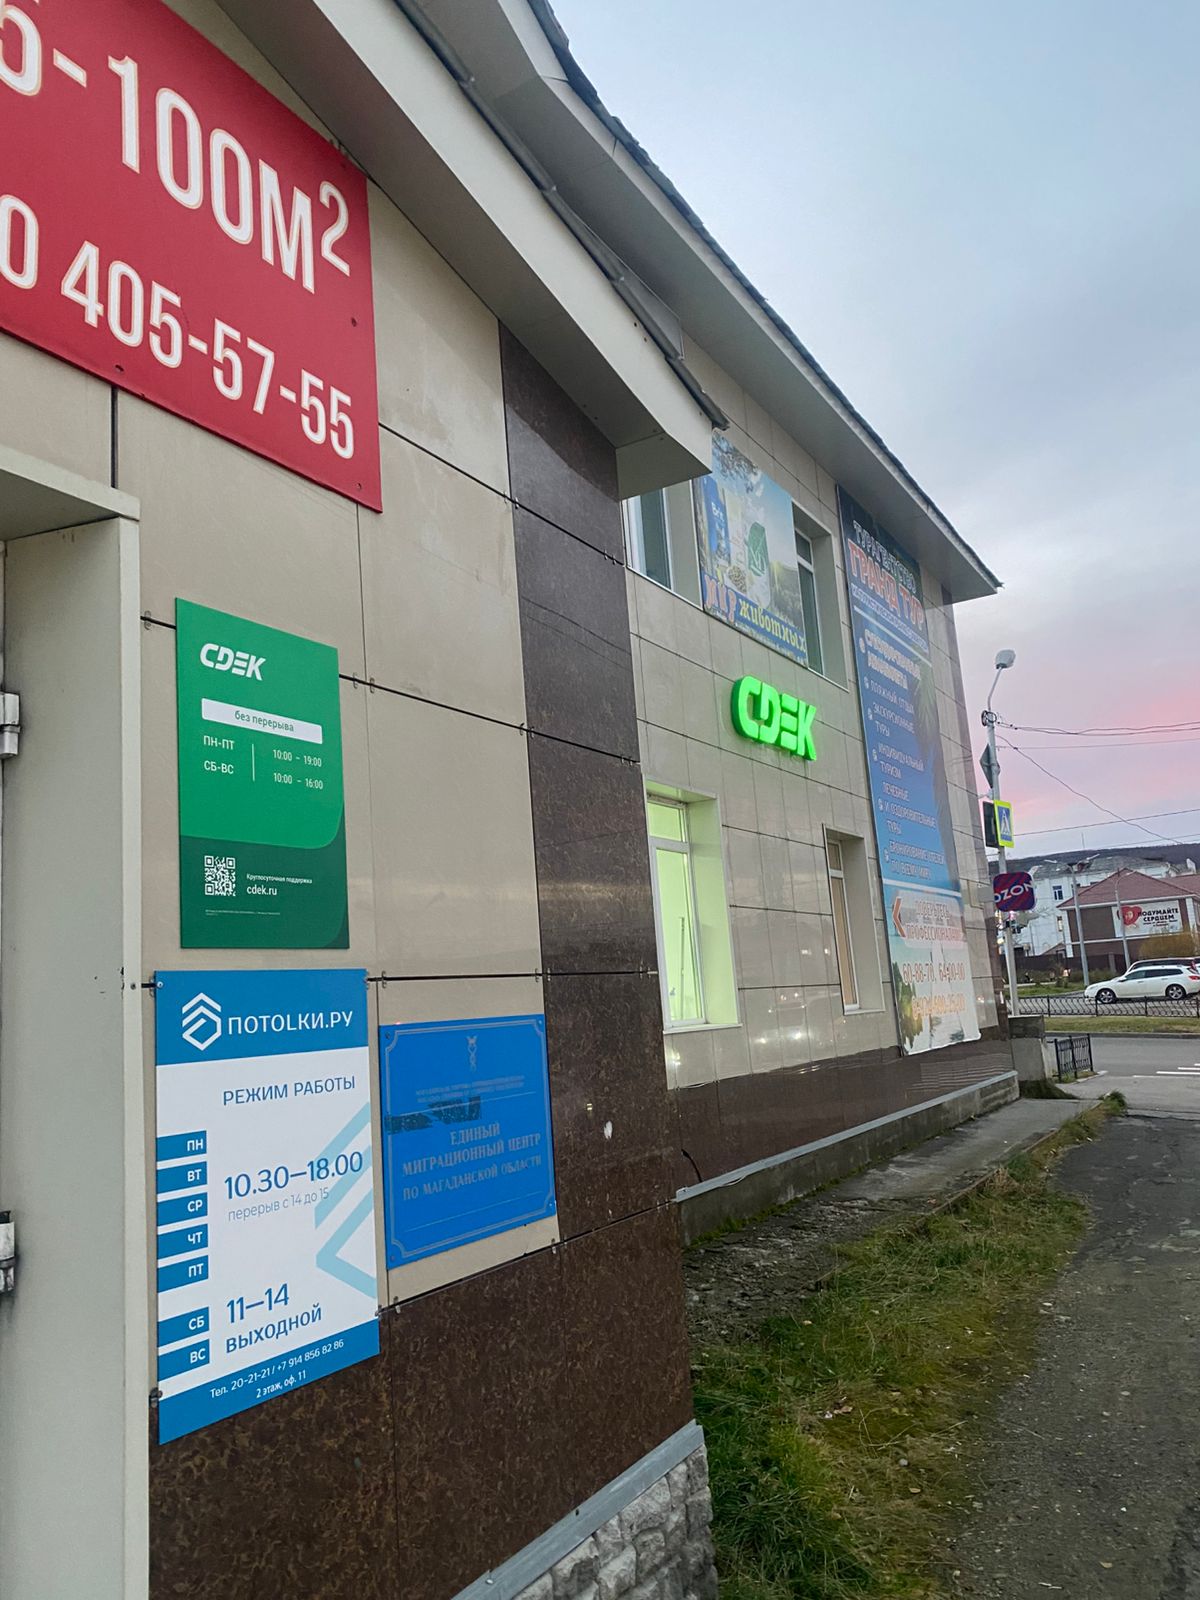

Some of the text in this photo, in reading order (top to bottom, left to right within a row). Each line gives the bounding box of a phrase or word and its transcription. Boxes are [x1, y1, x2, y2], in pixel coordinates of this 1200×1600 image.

[61, 241, 354, 459] 405-57-55
[848, 538, 901, 618] ГРАНД
[899, 583, 924, 631] ТУР
[200, 643, 266, 681] CDEK
[234, 710, 294, 732] без перерыва
[730, 674, 817, 762] CDEK
[203, 735, 235, 750] ПН-ПТ
[273, 749, 293, 761] 10:00
[303, 755, 322, 767] 19:00
[204, 760, 234, 774] СБ-ВС
[273, 773, 292, 784] 10:00
[305, 778, 323, 789] 16:00
[247, 884, 277, 895] cdek.ru
[223, 1076, 356, 1106] РЕЖИМ РАБОТЫ
[187, 1139, 204, 1151] ПН
[450, 1122, 500, 1146] ЕДИНЫЙ
[402, 1133, 541, 1177] МИГРАЦИОННЫЙ ЦЕНТР
[187, 1169, 202, 1182] ВТ
[403, 1155, 542, 1201] ПО МАГАДАНСКОЙ ОБЛАСТИ
[187, 1199, 203, 1212] СР
[228, 1201, 280, 1221] перерыв
[290, 1194, 302, 1206] 14
[304, 1192, 317, 1205] до
[320, 1187, 329, 1200] 15
[188, 1231, 203, 1244] ЧТ
[188, 1263, 204, 1277] ПТ
[188, 1316, 205, 1331] СБ
[190, 1348, 206, 1364] ВС
[210, 1386, 228, 1398] Тел.
[231, 1368, 271, 1390] 20-21-21
[277, 1361, 287, 1371] +7
[288, 1355, 303, 1368] 914
[304, 1348, 320, 1361] 856
[321, 1344, 332, 1355] 82
[333, 1339, 344, 1350] 86
[256, 1370, 306, 1398] 2 этаж, оф. 11
